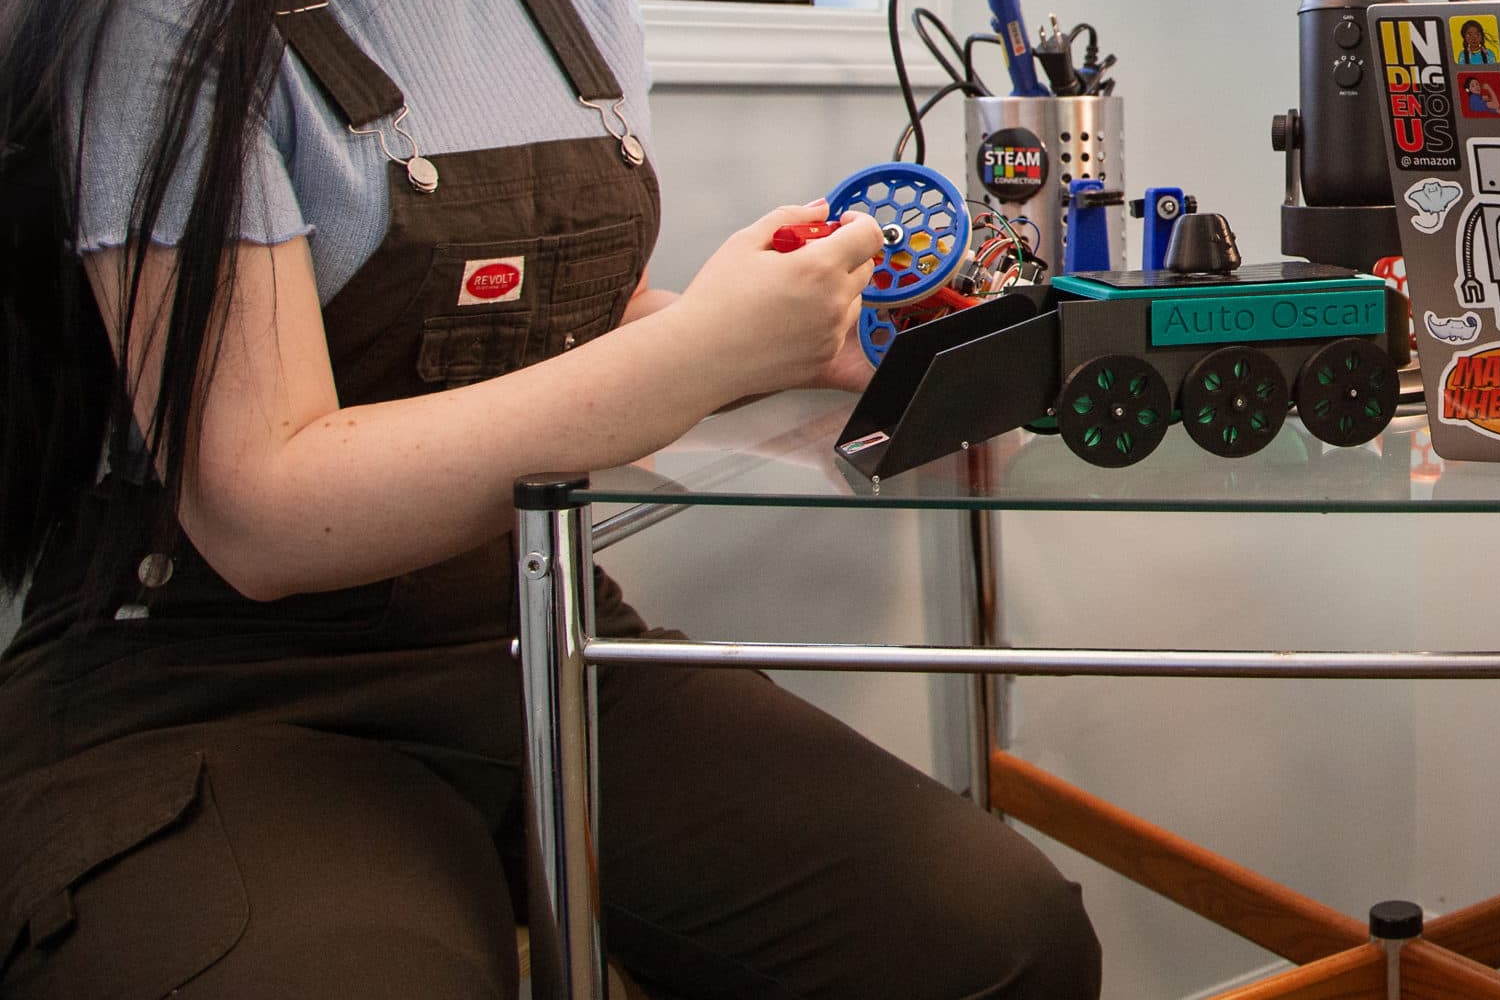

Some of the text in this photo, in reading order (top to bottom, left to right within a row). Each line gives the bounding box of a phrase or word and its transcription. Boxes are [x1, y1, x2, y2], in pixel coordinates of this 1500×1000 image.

[1380, 20, 1442, 65] IN
[1386, 65, 1447, 93] DIG
[1391, 94, 1450, 117] ENO
[1394, 118, 1453, 153] US
[984, 151, 1041, 166] STEAM
[1413, 156, 1456, 166] amazon
[473, 272, 516, 286] REVOLT
[1163, 300, 1378, 335] Auto Oscar
